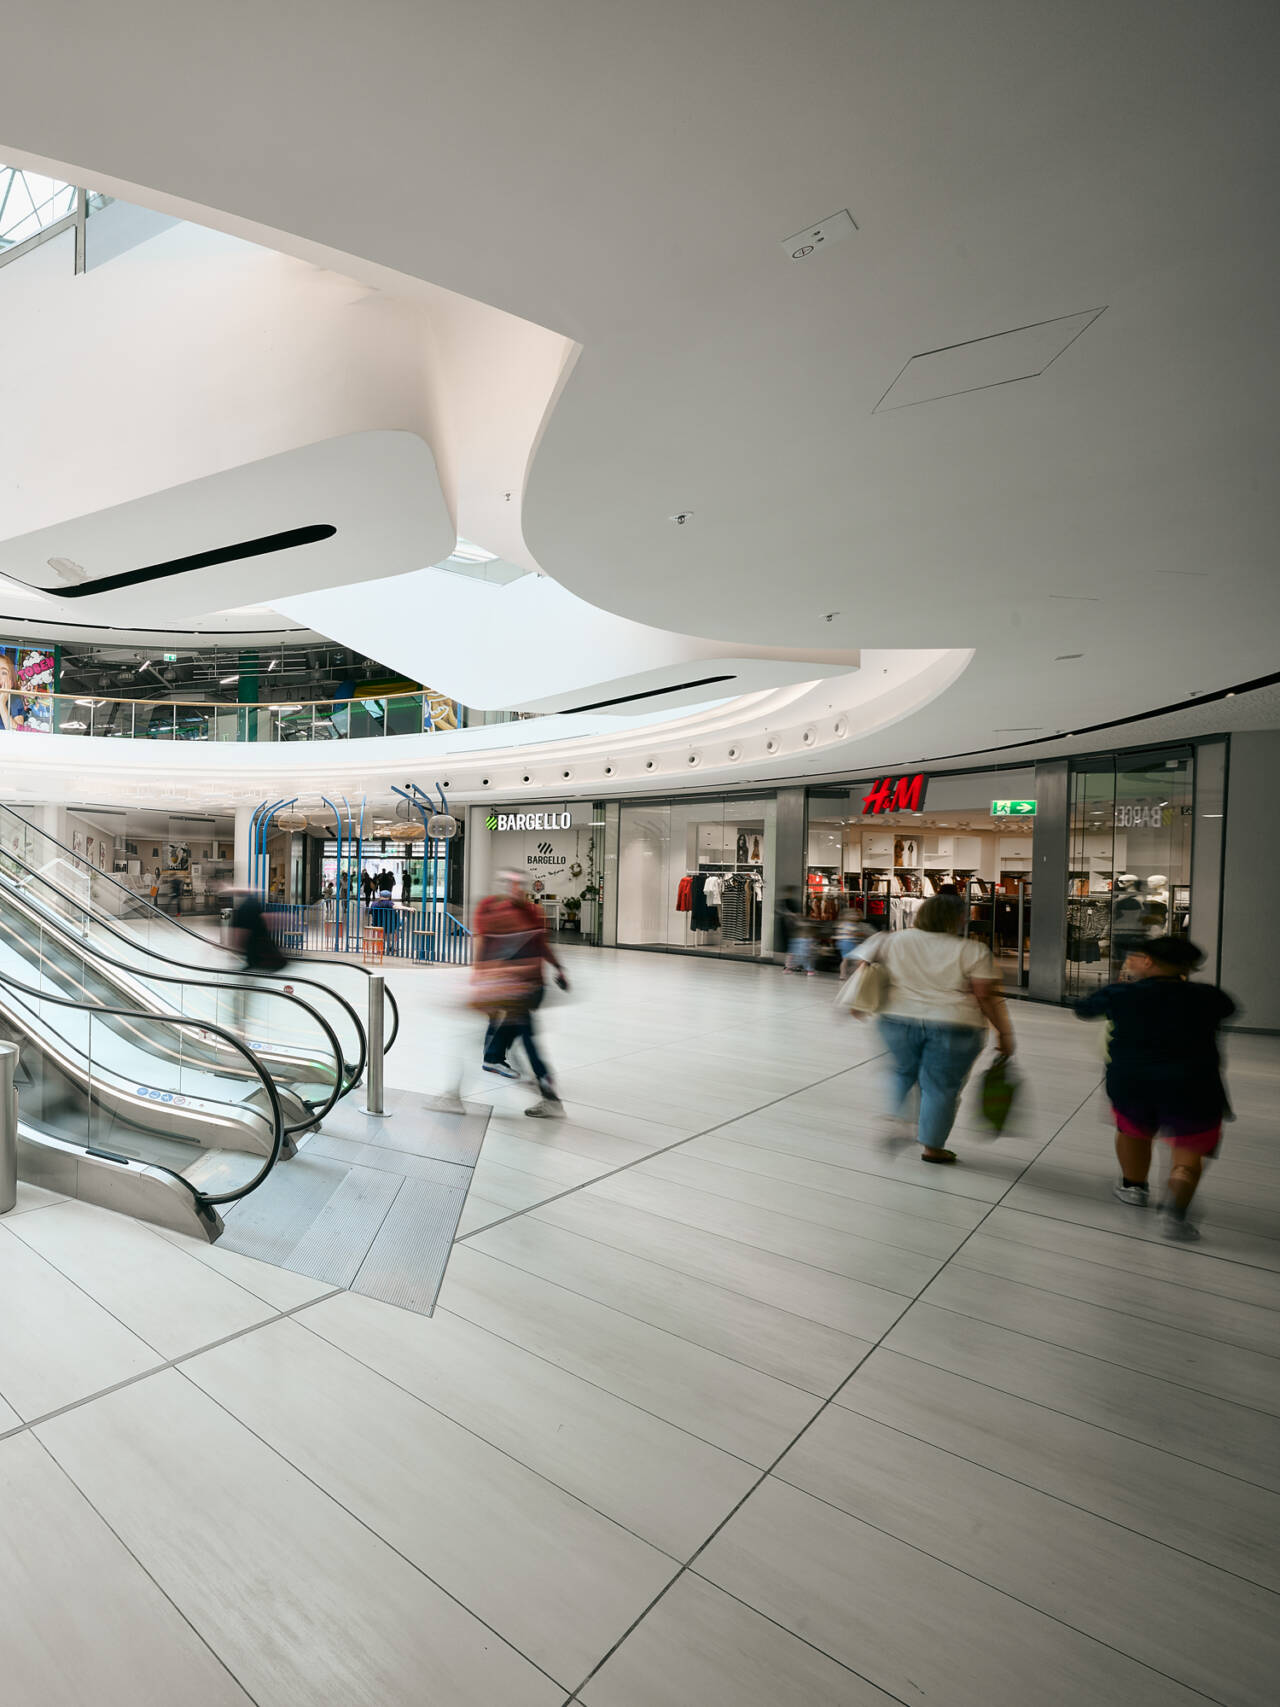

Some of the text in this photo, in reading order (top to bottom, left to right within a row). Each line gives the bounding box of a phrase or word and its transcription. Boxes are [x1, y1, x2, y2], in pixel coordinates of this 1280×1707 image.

[862, 774, 924, 814] H&M
[497, 812, 571, 831] BARGELLO
[527, 855, 566, 865] BARGELLO
